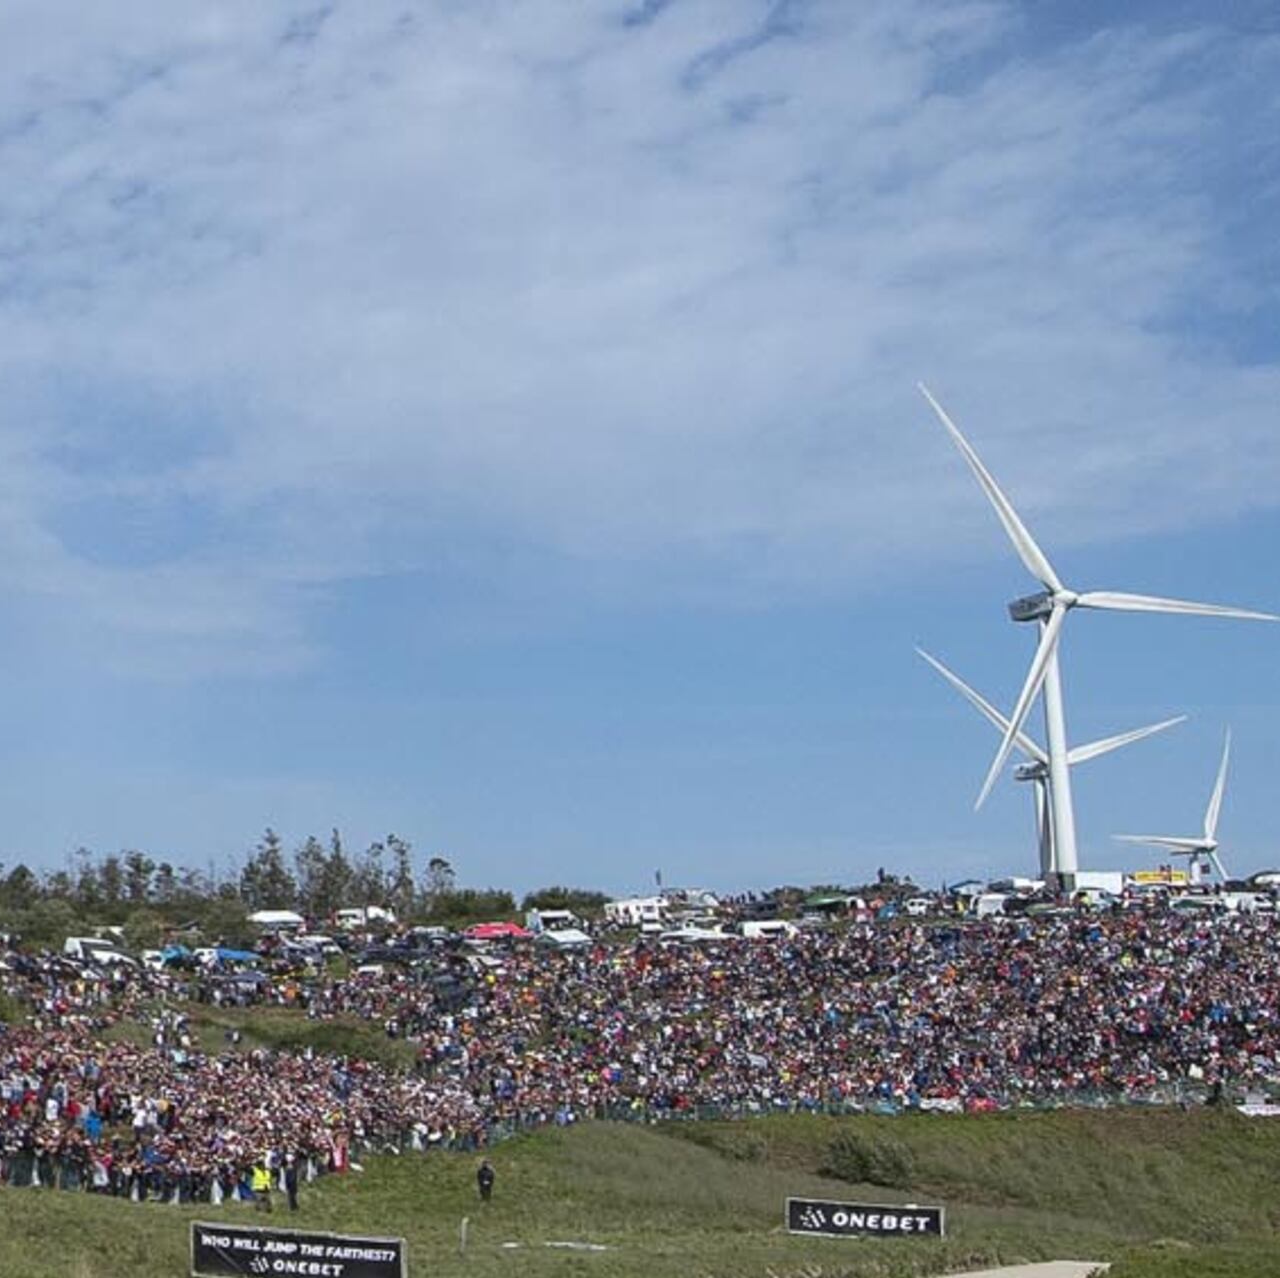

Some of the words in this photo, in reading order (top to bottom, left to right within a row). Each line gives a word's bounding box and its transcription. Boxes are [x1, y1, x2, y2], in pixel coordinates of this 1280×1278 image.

[832, 1212, 930, 1231] ONEBET
[201, 1234, 231, 1248] WHO
[233, 1237, 261, 1251] WILL
[263, 1240, 298, 1254] JUMP
[300, 1244, 324, 1257] THE
[326, 1246, 397, 1262] FARTHEST?
[273, 1260, 344, 1277] ONEBET
